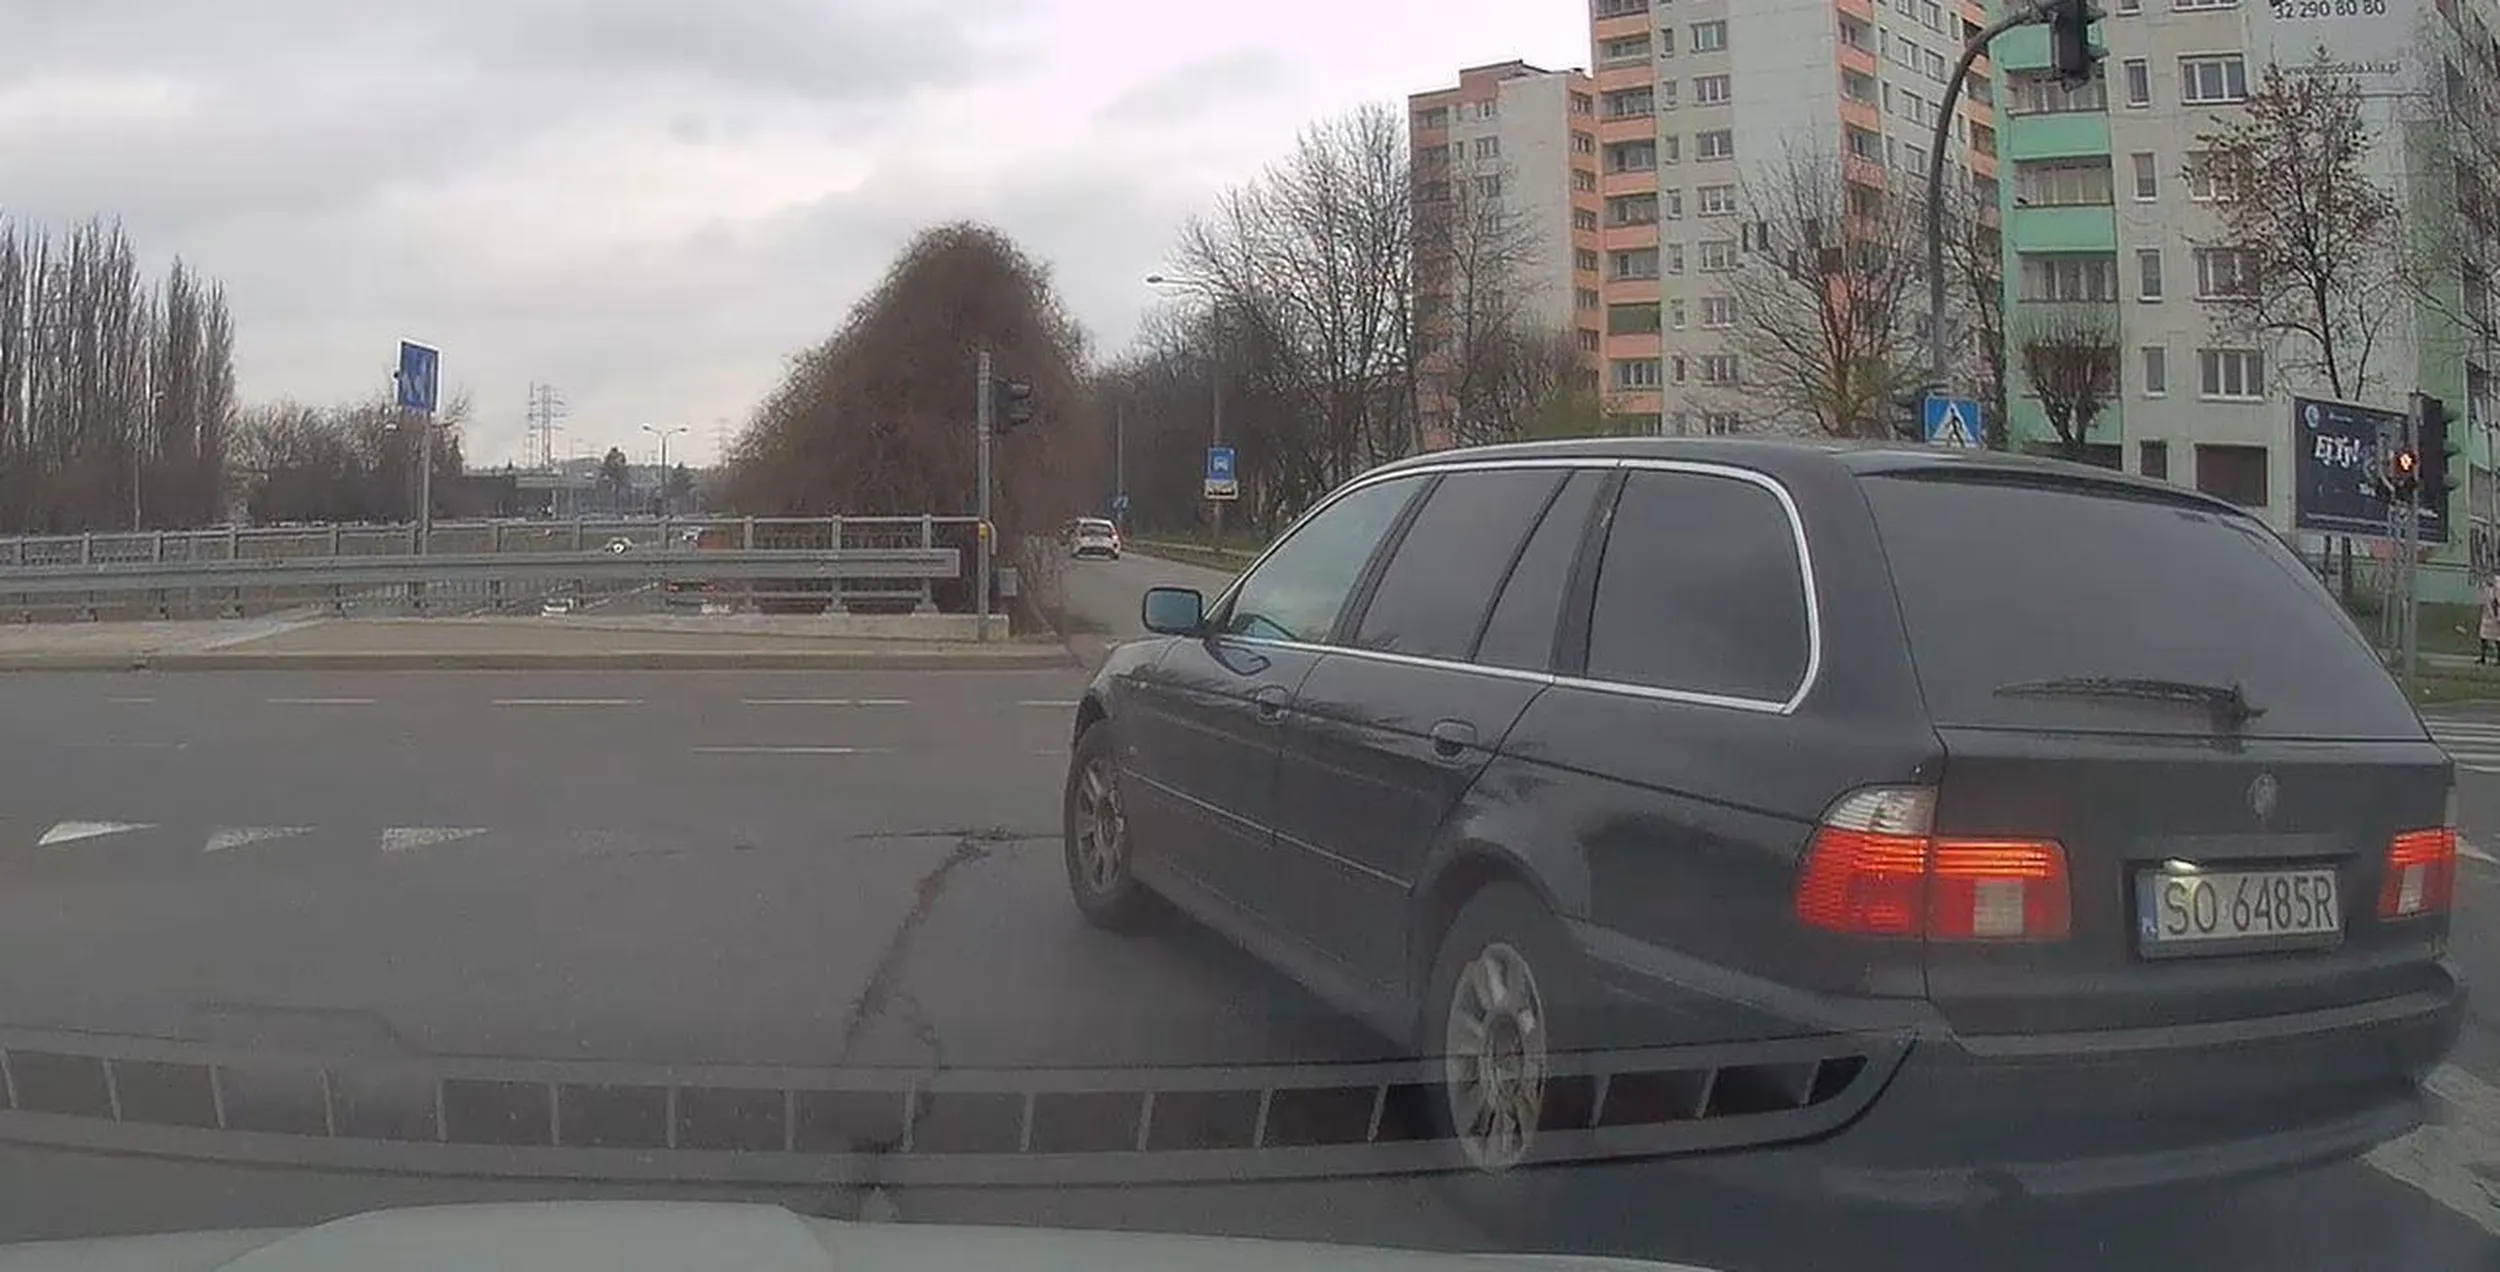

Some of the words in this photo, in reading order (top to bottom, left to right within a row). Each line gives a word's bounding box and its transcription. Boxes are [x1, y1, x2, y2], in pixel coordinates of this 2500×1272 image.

[2274, 2, 2294, 19] 32
[2298, 0, 2330, 18] 290
[2336, 0, 2357, 16] 80
[2363, 0, 2385, 15] 80
[2164, 879, 2218, 935] SO
[2232, 875, 2335, 931] 6485R
